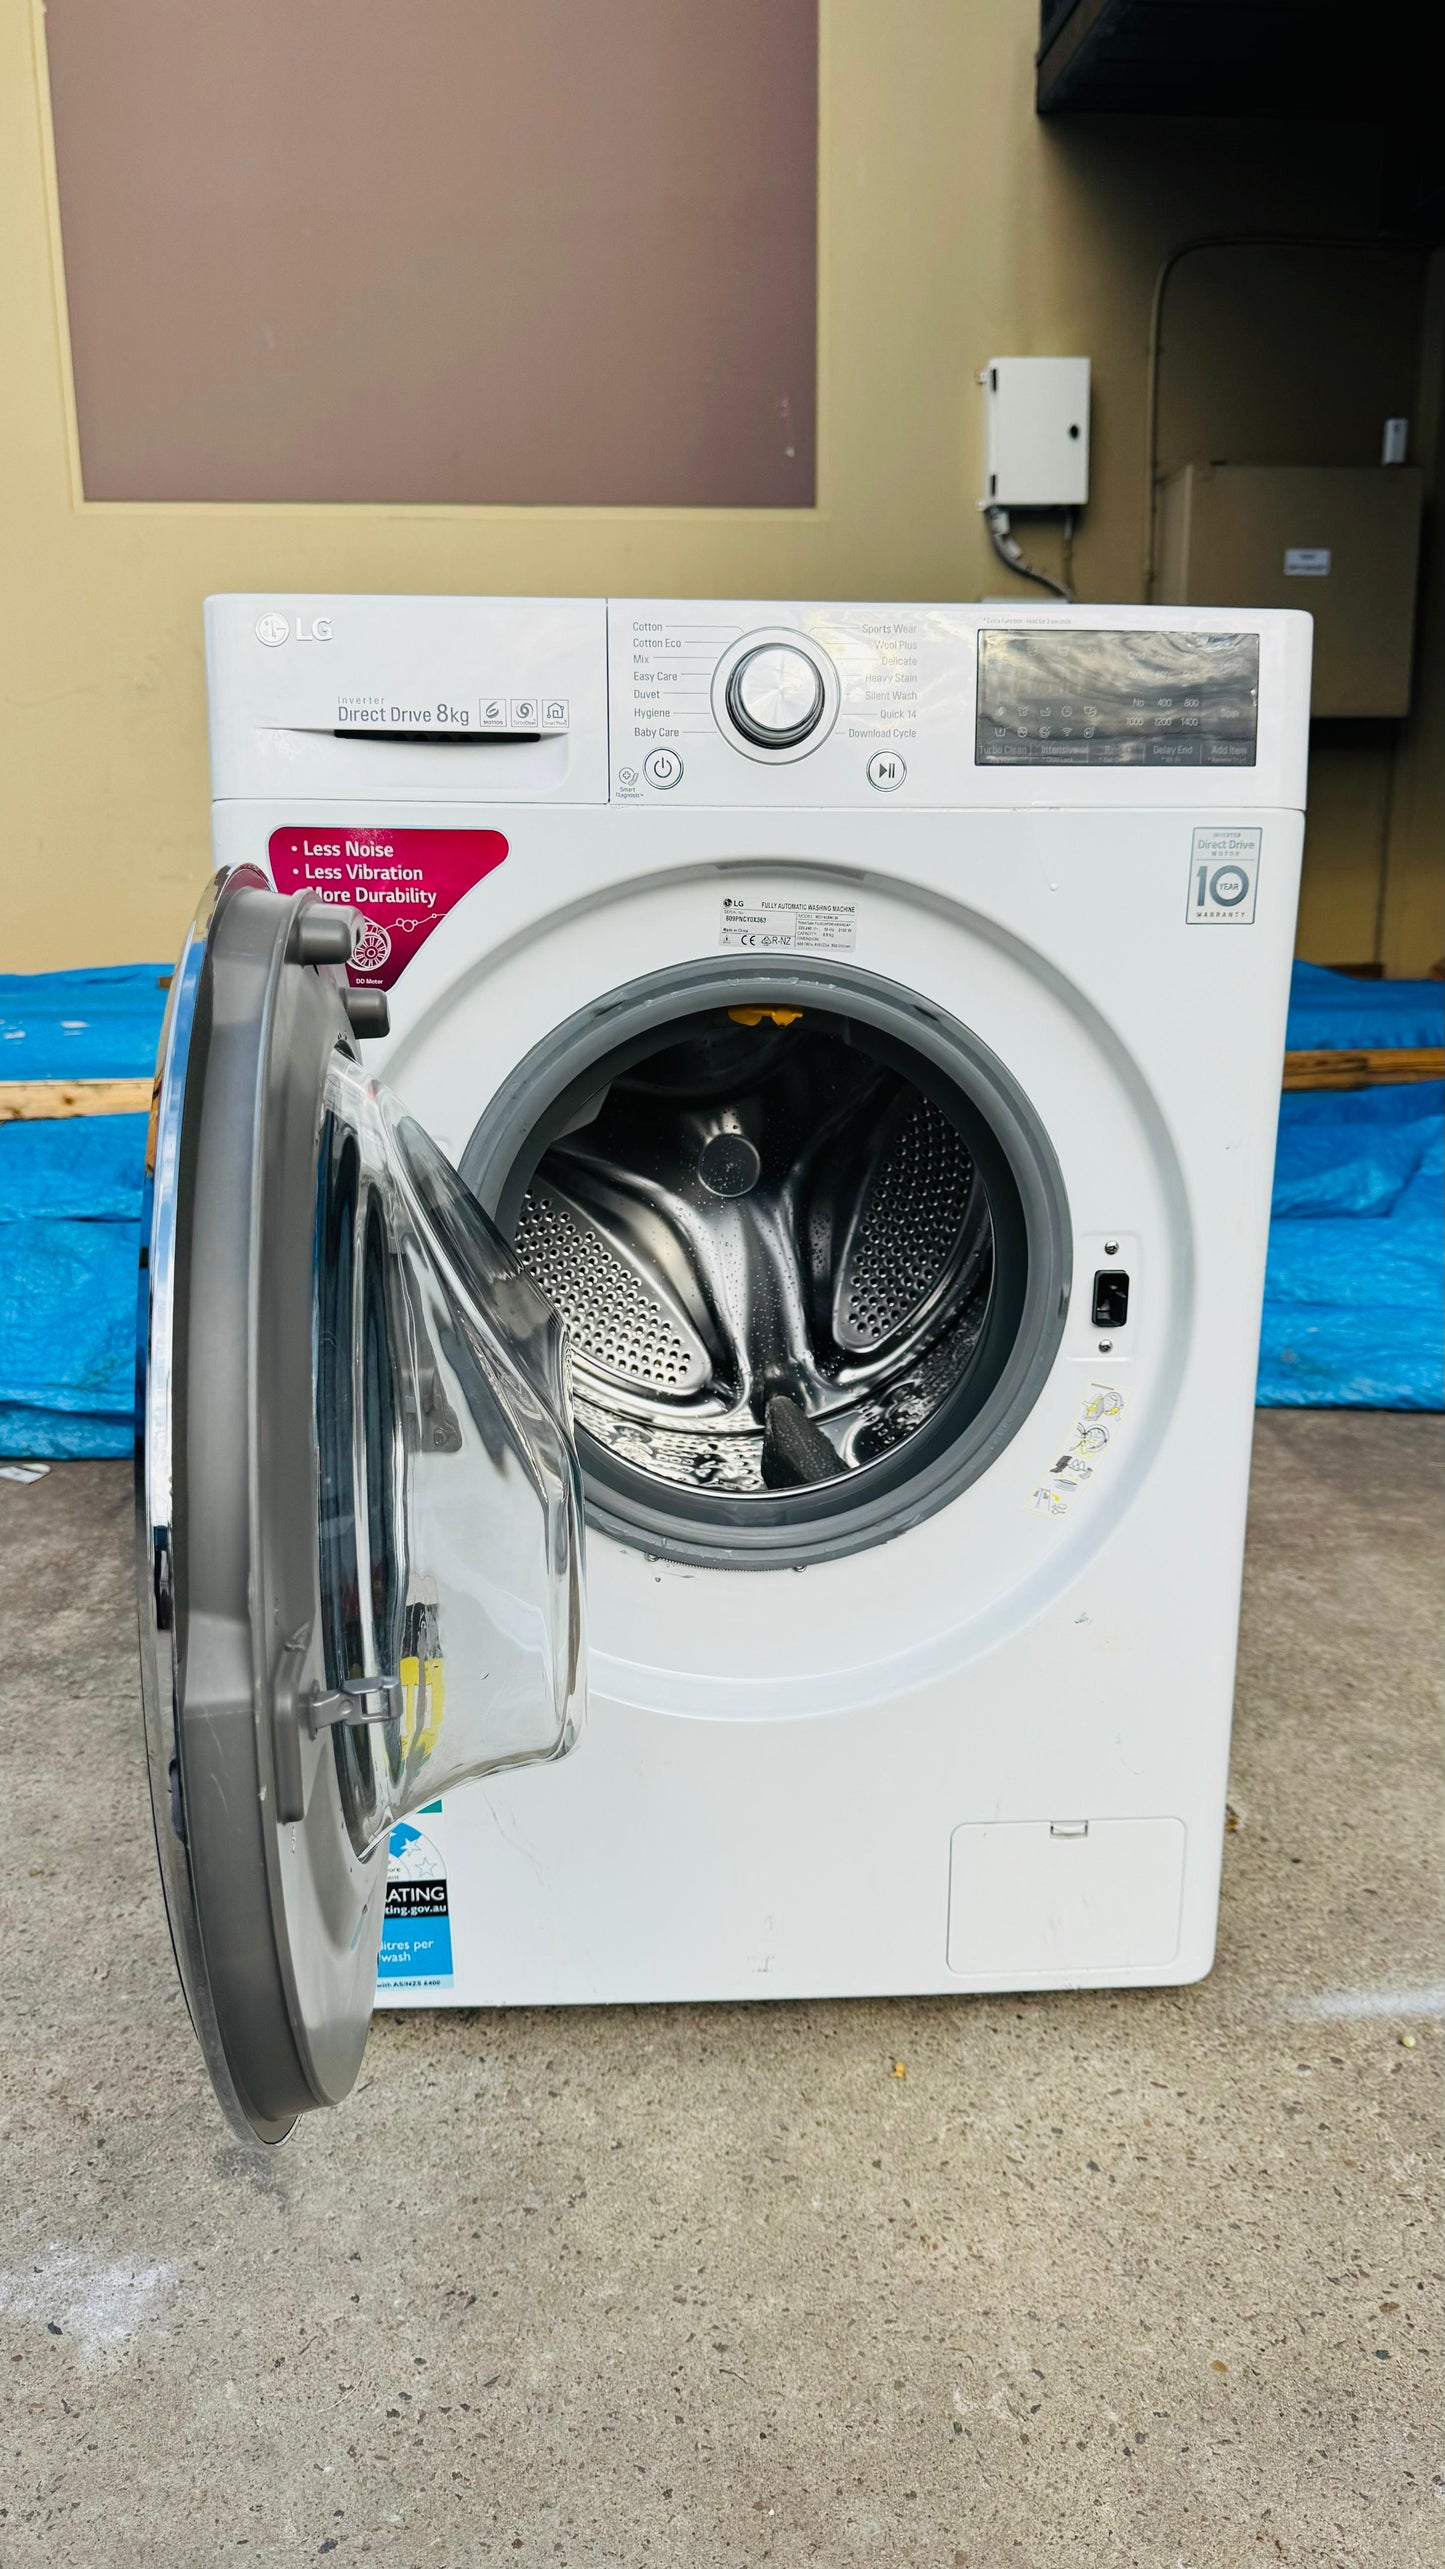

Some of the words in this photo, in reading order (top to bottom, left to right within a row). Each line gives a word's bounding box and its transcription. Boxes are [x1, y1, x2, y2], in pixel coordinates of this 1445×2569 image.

[295, 617, 333, 641] LG
[632, 621, 663, 632] Cotton
[862, 624, 892, 634] Sports
[893, 624, 918, 634] Wear
[632, 638, 663, 648] Cotton
[664, 638, 682, 648] Eco
[874, 640, 897, 650] Wool
[899, 640, 918, 650] Plus
[633, 654, 650, 664] Mix
[881, 656, 918, 666] Delicate
[633, 671, 655, 683] Easy
[657, 671, 678, 681] Care
[865, 673, 893, 685] Heavy
[895, 673, 918, 683] Stain
[633, 689, 660, 699] Duvet
[865, 690, 890, 701] Silent
[892, 690, 918, 701] Wash
[337, 696, 385, 705] Inverter
[1132, 698, 1145, 707] No
[1158, 698, 1173, 707] 400
[1183, 698, 1200, 707] 800
[338, 706, 386, 722] Direct
[390, 706, 432, 723] Drive
[436, 703, 470, 726] 8kg
[634, 707, 671, 719] Hygiene
[880, 709, 905, 719] Quick
[907, 709, 917, 719] 14
[1126, 717, 1144, 727] 1000
[1154, 717, 1172, 727] 1200
[1181, 717, 1199, 727] 1400
[634, 727, 657, 739] Baby
[658, 727, 680, 737] Care
[848, 728, 891, 738] Download
[893, 728, 917, 740] Cycle
[979, 745, 1003, 755] Turbo
[1003, 745, 1027, 755] Clean
[1153, 745, 1176, 756] Delay
[1177, 745, 1193, 755] End
[1211, 745, 1228, 755] Add
[1229, 745, 1247, 755] Item
[303, 840, 341, 857] Less
[345, 840, 394, 857] Noise
[1197, 840, 1227, 850] Direct
[1228, 840, 1255, 850] Drive
[305, 863, 342, 879] Less
[345, 863, 423, 881] Vibration
[1196, 865, 1249, 907] 10
[1219, 882, 1239, 890] YEAR
[355, 886, 437, 908] Durability
[778, 903, 807, 911] AUTOMATIC
[808, 904, 832, 912] WASHING
[832, 905, 855, 913] MACHINE
[386, 1886, 445, 1903] ATING
[385, 1904, 447, 1916] ting.gov.au
[380, 1940, 410, 1951] litres
[413, 1940, 434, 1952] per
[381, 1951, 411, 1963] wash
